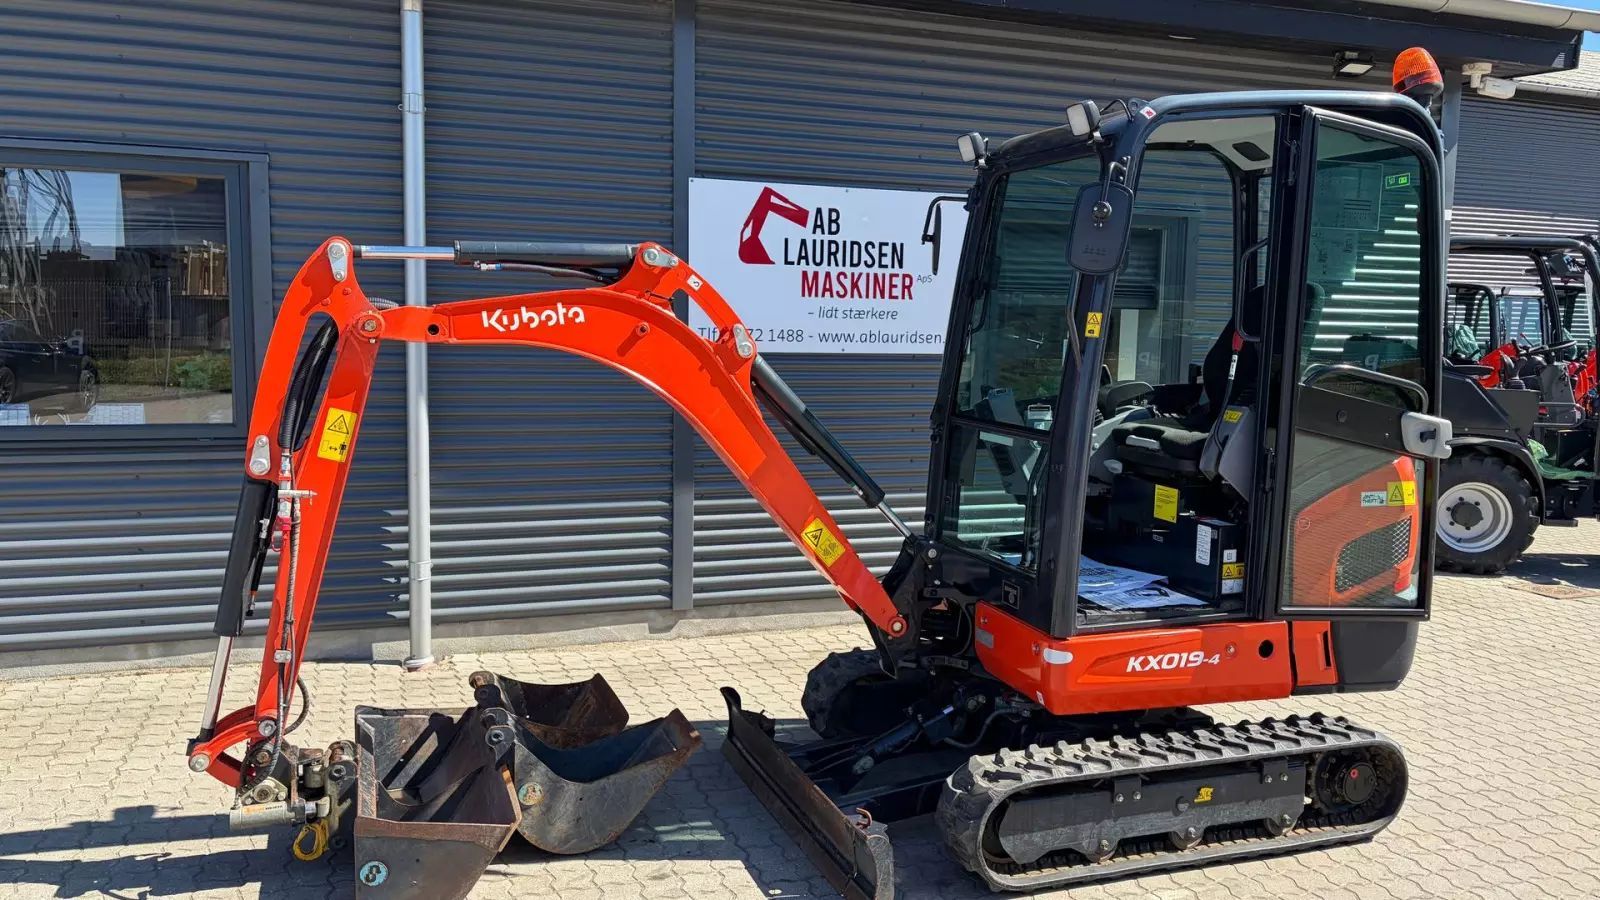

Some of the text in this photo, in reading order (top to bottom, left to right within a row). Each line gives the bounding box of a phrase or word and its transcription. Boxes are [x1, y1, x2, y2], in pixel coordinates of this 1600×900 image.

[812, 207, 841, 236] AB
[784, 237, 905, 269] LAURIDSEN
[801, 270, 933, 300] MASKINER ApS
[481, 302, 586, 332] Kubota
[818, 306, 839, 319] lidt
[841, 307, 899, 321] stærkere
[768, 328, 804, 343] 1488
[1126, 650, 1221, 673] KX019-4
